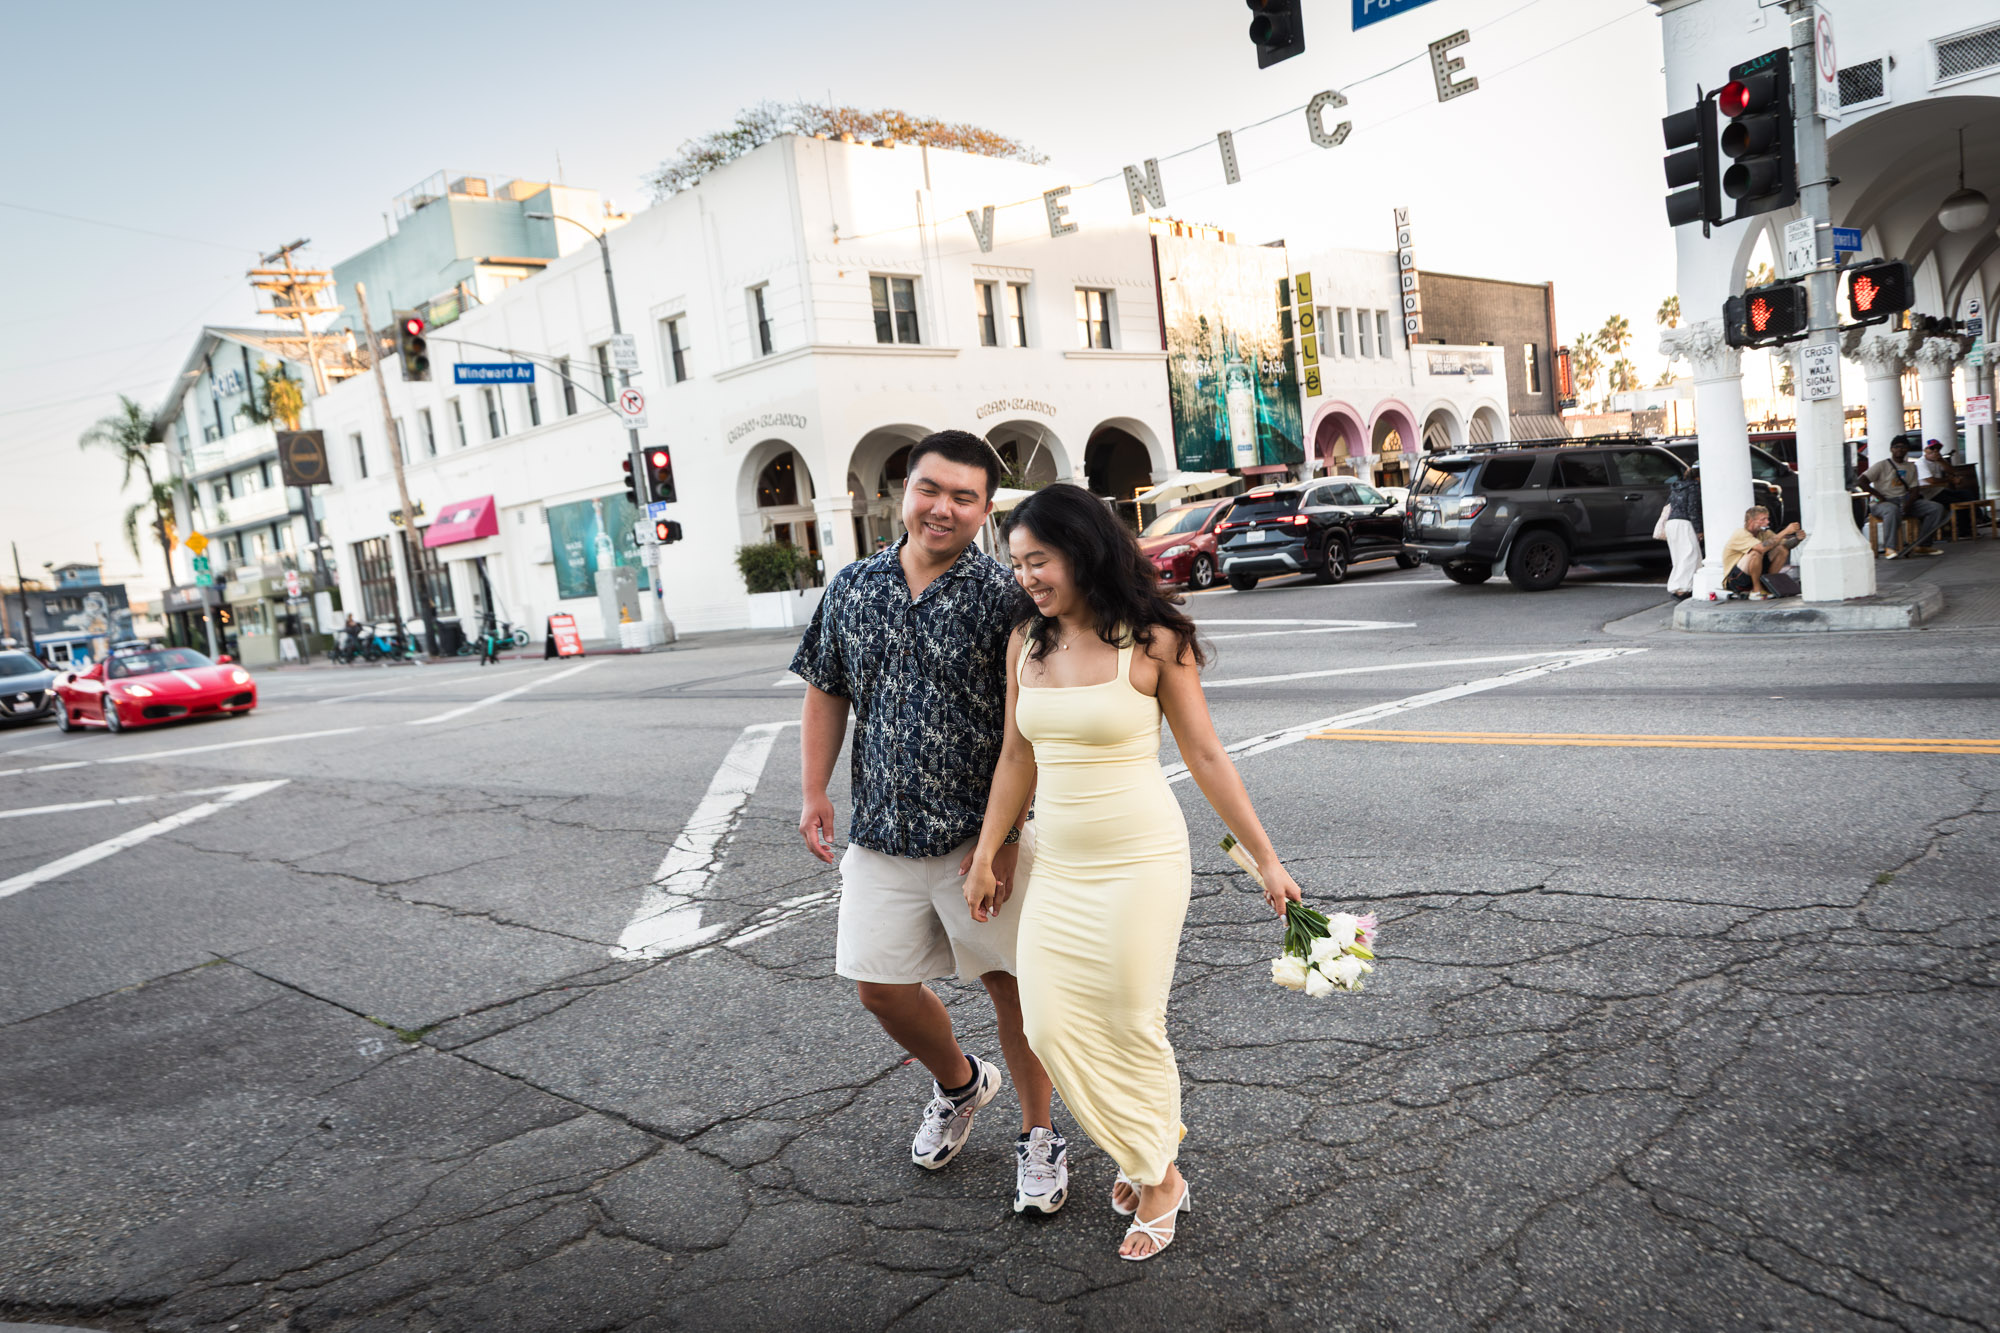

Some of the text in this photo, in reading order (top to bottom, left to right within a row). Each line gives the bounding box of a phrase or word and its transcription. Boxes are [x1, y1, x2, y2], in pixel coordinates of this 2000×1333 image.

[966, 29, 1479, 254] VENICE
[1788, 250, 1799, 271] OK
[1399, 210, 1417, 331] VOODOO
[1805, 346, 1833, 358] CROSS
[1183, 360, 1213, 374] CASA
[1262, 361, 1287, 374] CASA
[1815, 358, 1824, 366] ON
[457, 366, 531, 379] Windward Av
[1809, 365, 1831, 376] WALK
[1806, 375, 1836, 387] SIGNAL
[1811, 386, 1832, 397] ONLY
